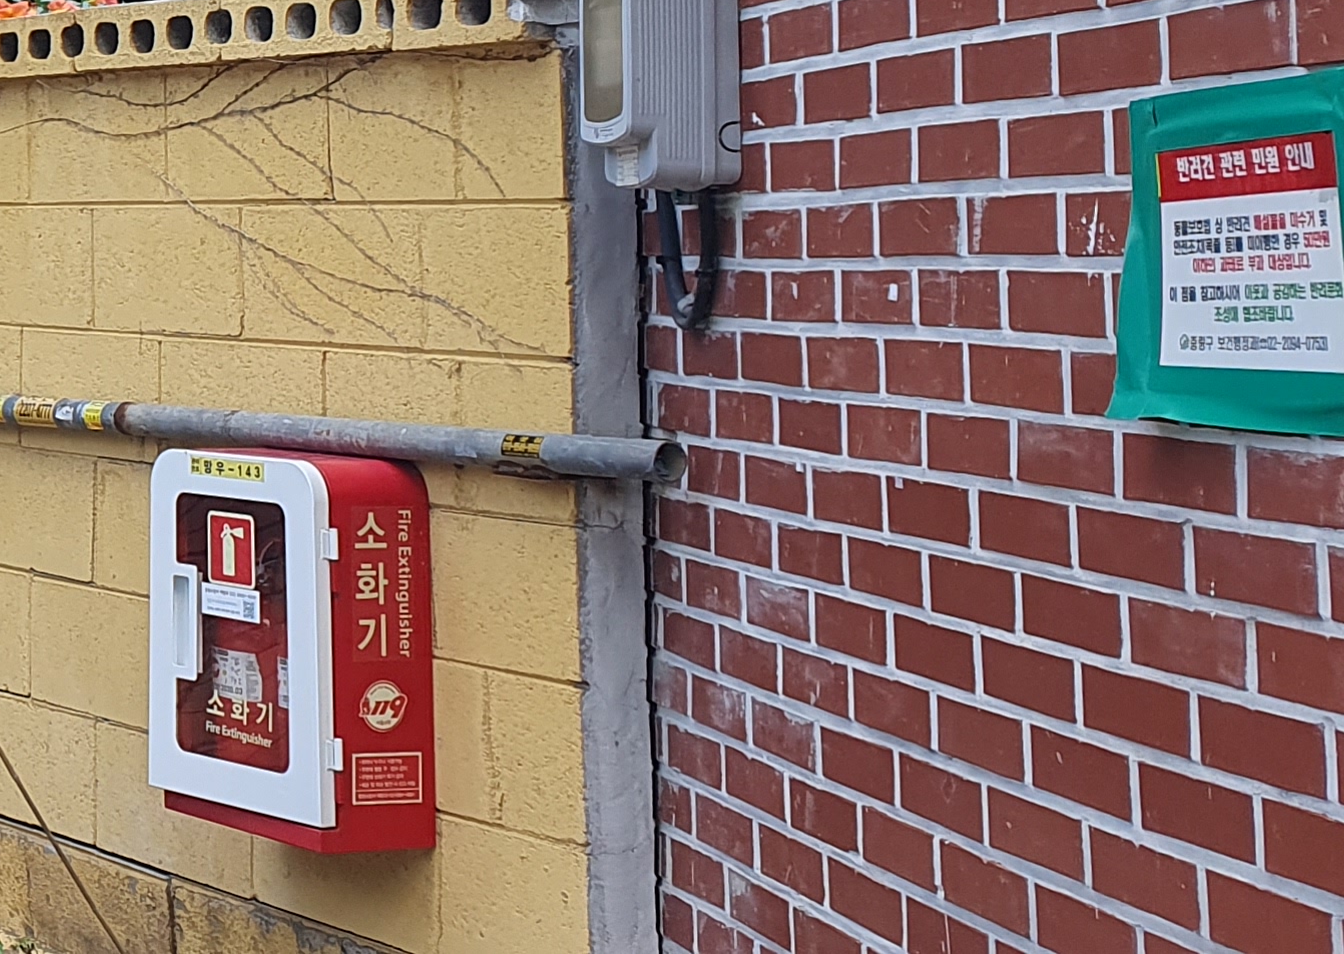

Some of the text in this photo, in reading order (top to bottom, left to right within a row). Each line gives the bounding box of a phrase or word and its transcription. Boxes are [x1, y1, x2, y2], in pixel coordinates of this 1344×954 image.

[1176, 142, 1314, 182] 반려견 관련 민원 안내
[354, 511, 389, 657] 소화기
[395, 509, 413, 658] Fire Extinguisher
[206, 689, 273, 733] 소화기
[205, 720, 273, 748] Fire Extinguisher
